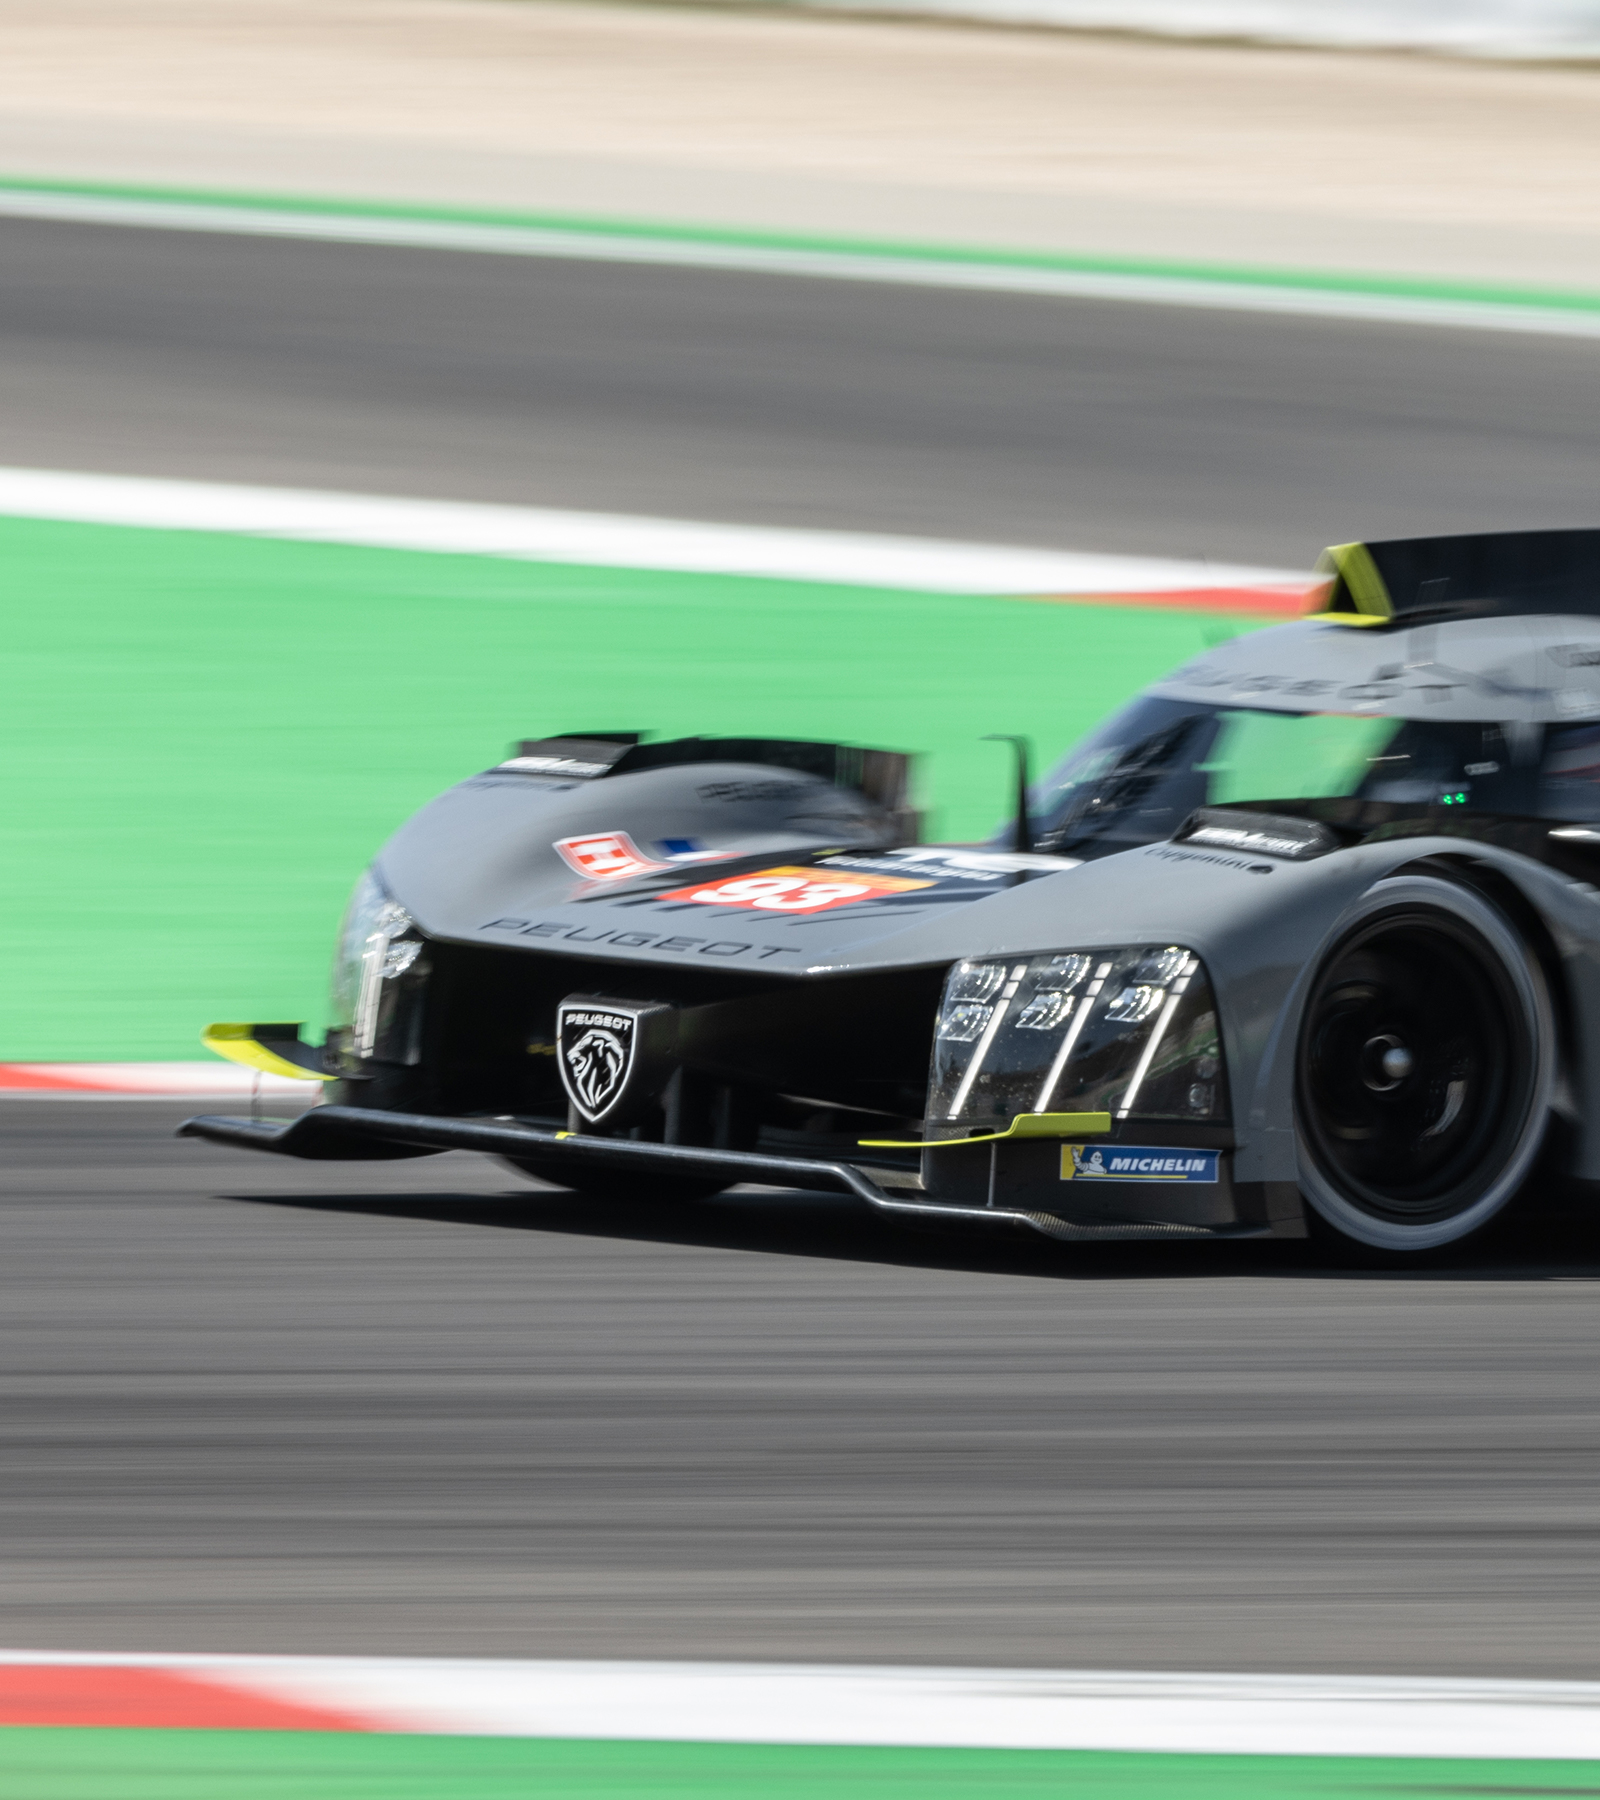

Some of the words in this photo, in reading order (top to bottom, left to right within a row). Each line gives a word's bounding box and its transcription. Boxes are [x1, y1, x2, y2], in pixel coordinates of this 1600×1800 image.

[690, 876, 872, 910] 93
[478, 907, 803, 959] PEUGEOT
[565, 1012, 632, 1031] PEUGEOT
[1109, 1157, 1206, 1172] MICHELIN
